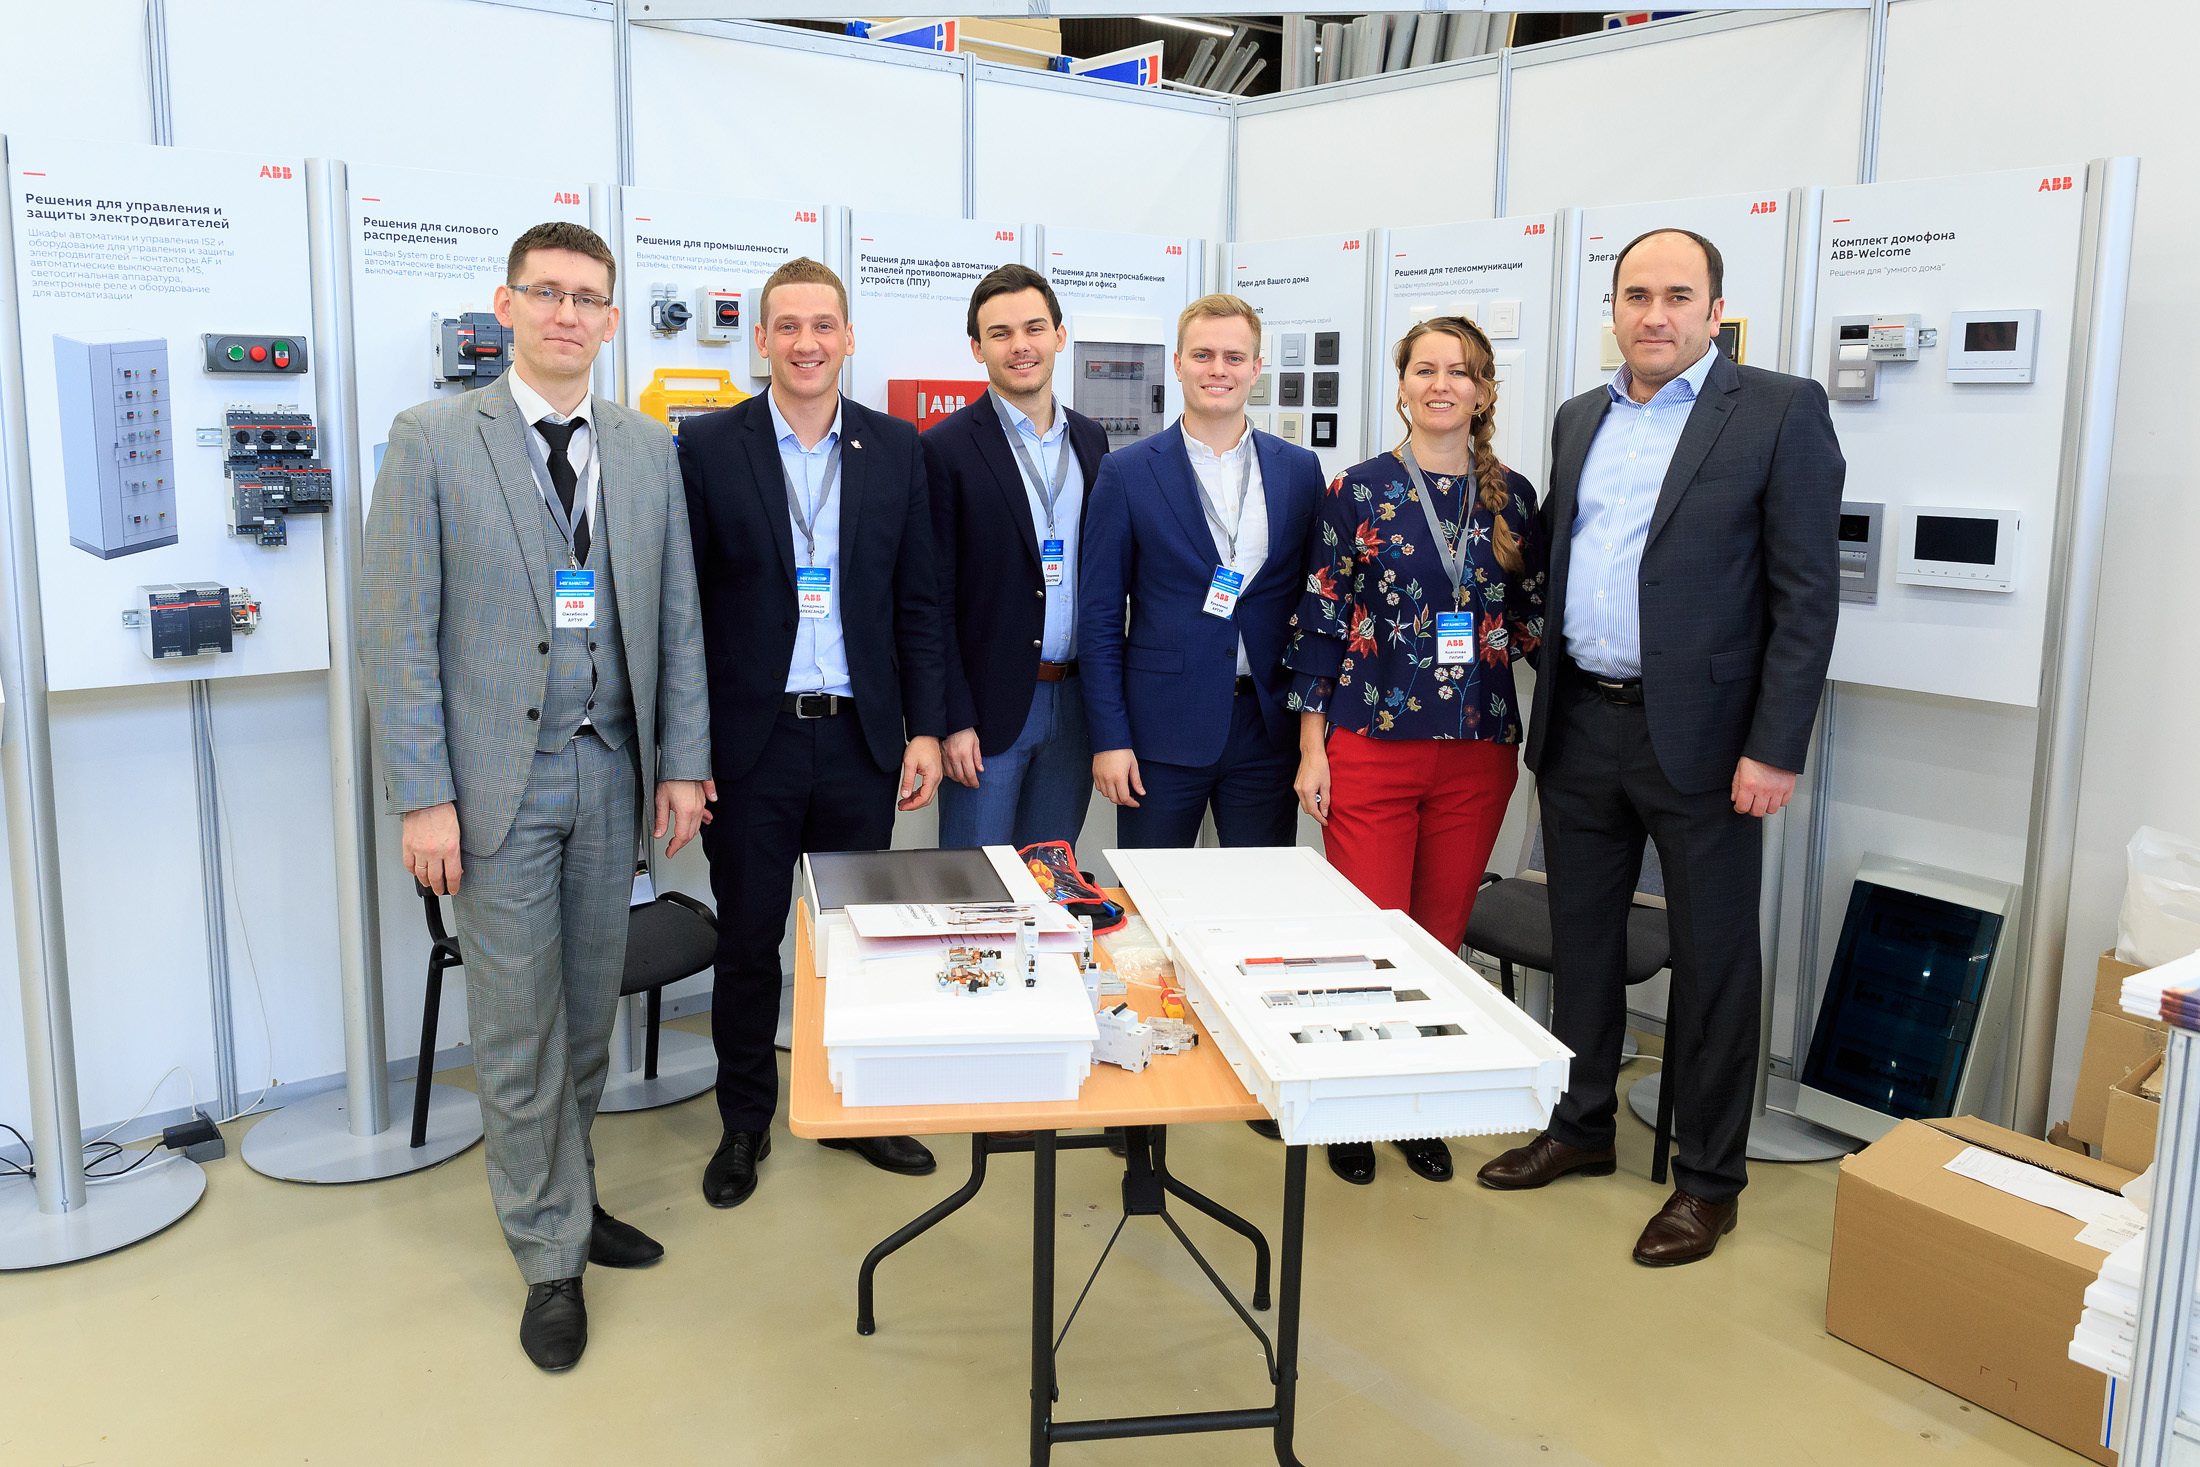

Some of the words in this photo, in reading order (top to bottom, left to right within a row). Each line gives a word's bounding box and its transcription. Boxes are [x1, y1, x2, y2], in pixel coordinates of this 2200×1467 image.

[260, 166, 292, 179] ABB
[2038, 177, 2072, 192] ABB
[26, 193, 92, 207] Решения
[96, 200, 122, 210] для
[126, 202, 210, 214] управления
[554, 192, 580, 205] ABB
[1750, 201, 1776, 215] ABB
[27, 210, 85, 221] защиты
[90, 213, 229, 229] электродвигателей
[795, 212, 817, 223] ABB
[364, 217, 417, 230] Решения
[420, 223, 441, 232] для
[445, 225, 498, 236] силового
[1524, 224, 1545, 236] ABB
[364, 232, 457, 245] распределения
[995, 231, 1014, 241] ABB
[1832, 237, 1888, 248] Комплект
[1891, 231, 1955, 246] домофона
[637, 235, 681, 246] Решения
[684, 240, 701, 248] для
[704, 242, 788, 254] промышленности
[1166, 246, 1182, 255] ABB
[1343, 240, 1360, 251] ABB
[1831, 248, 1911, 260] ABB-Welcome
[861, 254, 898, 264] Решения
[918, 259, 950, 268] шкафов
[952, 262, 999, 270] автоматики
[869, 266, 904, 274] панелей
[906, 269, 982, 280] противопожарных
[1052, 267, 1084, 276] Решения
[1100, 272, 1165, 282] электроснабжения
[1429, 268, 1443, 276] для
[1445, 262, 1523, 274] телекоммуникации
[861, 276, 904, 285] устройств
[907, 277, 930, 288] (ППУ)
[1052, 278, 1088, 287] квартиры
[1095, 280, 1117, 289] офиса
[930, 395, 966, 413] ABB
[1214, 592, 1229, 602] ABB
